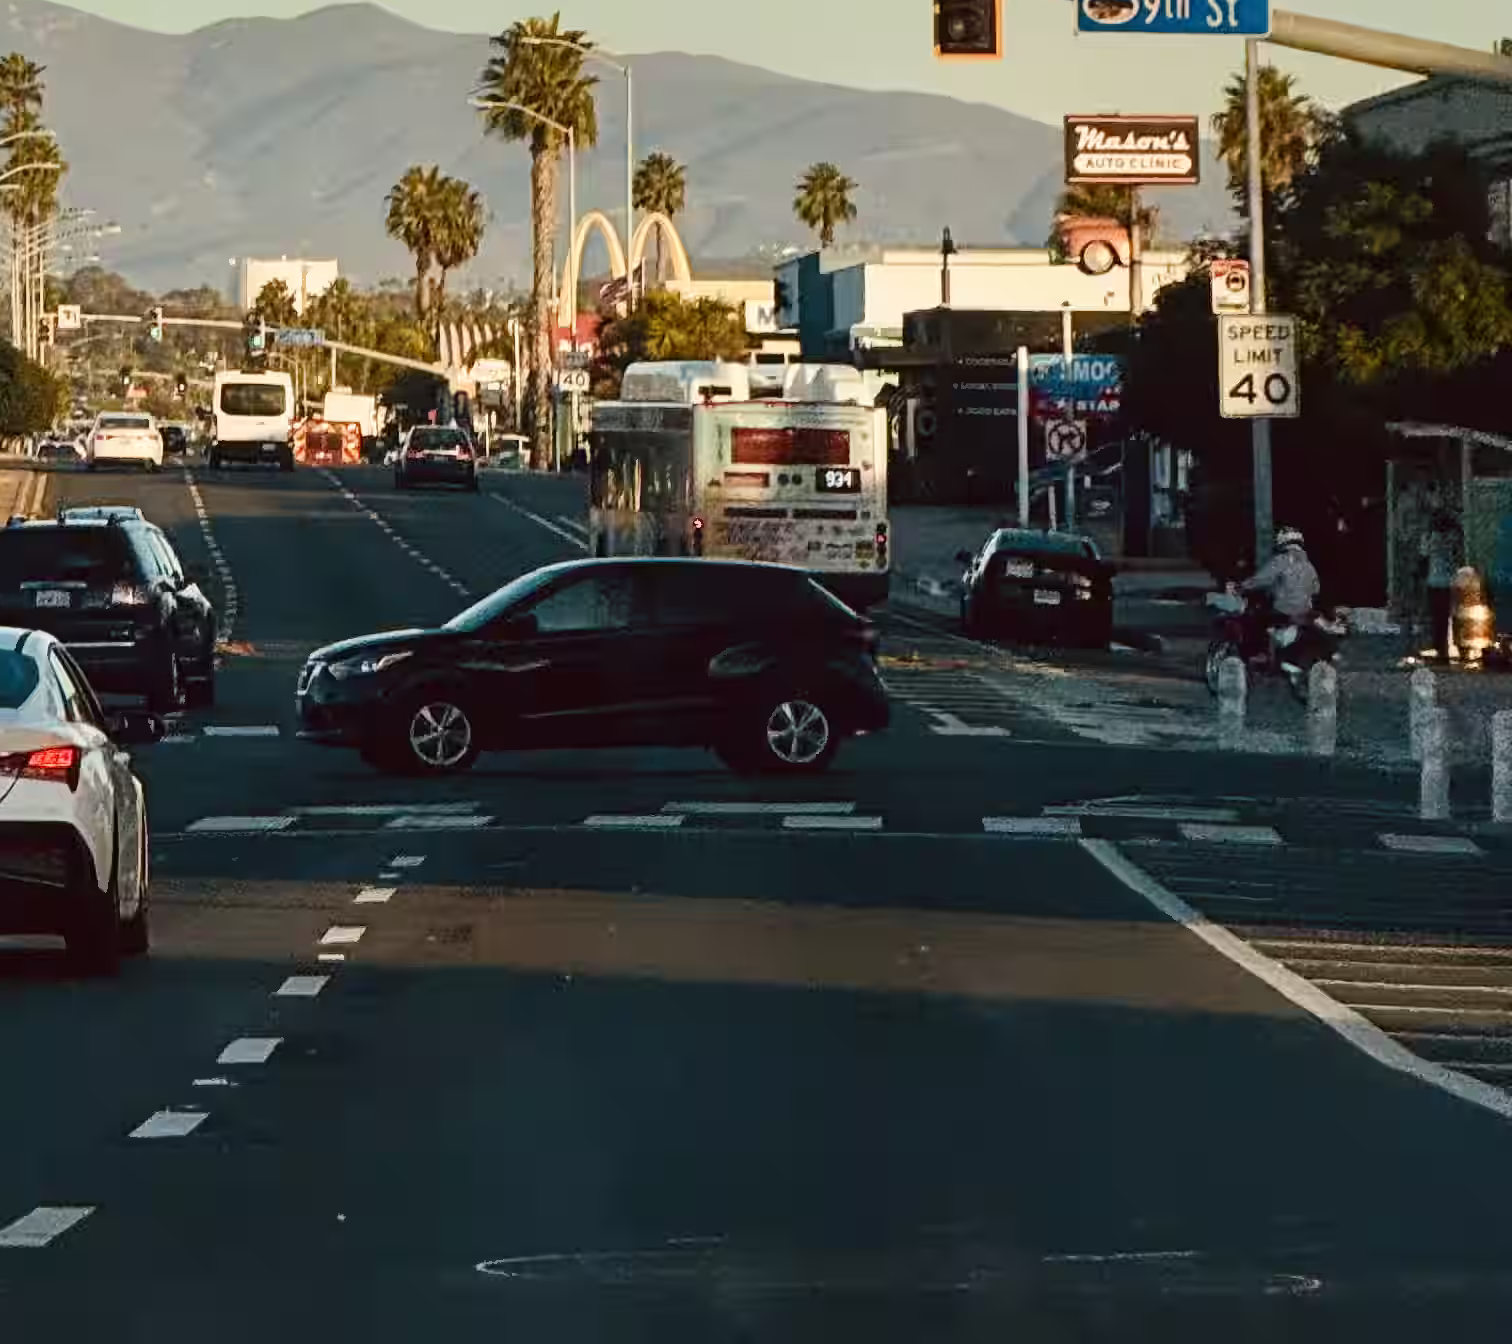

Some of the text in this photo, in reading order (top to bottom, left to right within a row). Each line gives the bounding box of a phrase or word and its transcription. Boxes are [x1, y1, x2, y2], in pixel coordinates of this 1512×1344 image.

[1074, 125, 1191, 150] Mason's
[1085, 156, 1180, 170] AUTO CLINIC
[1227, 325, 1289, 341] SPEED
[1234, 349, 1283, 364] LIMIT
[1229, 373, 1290, 404] 40
